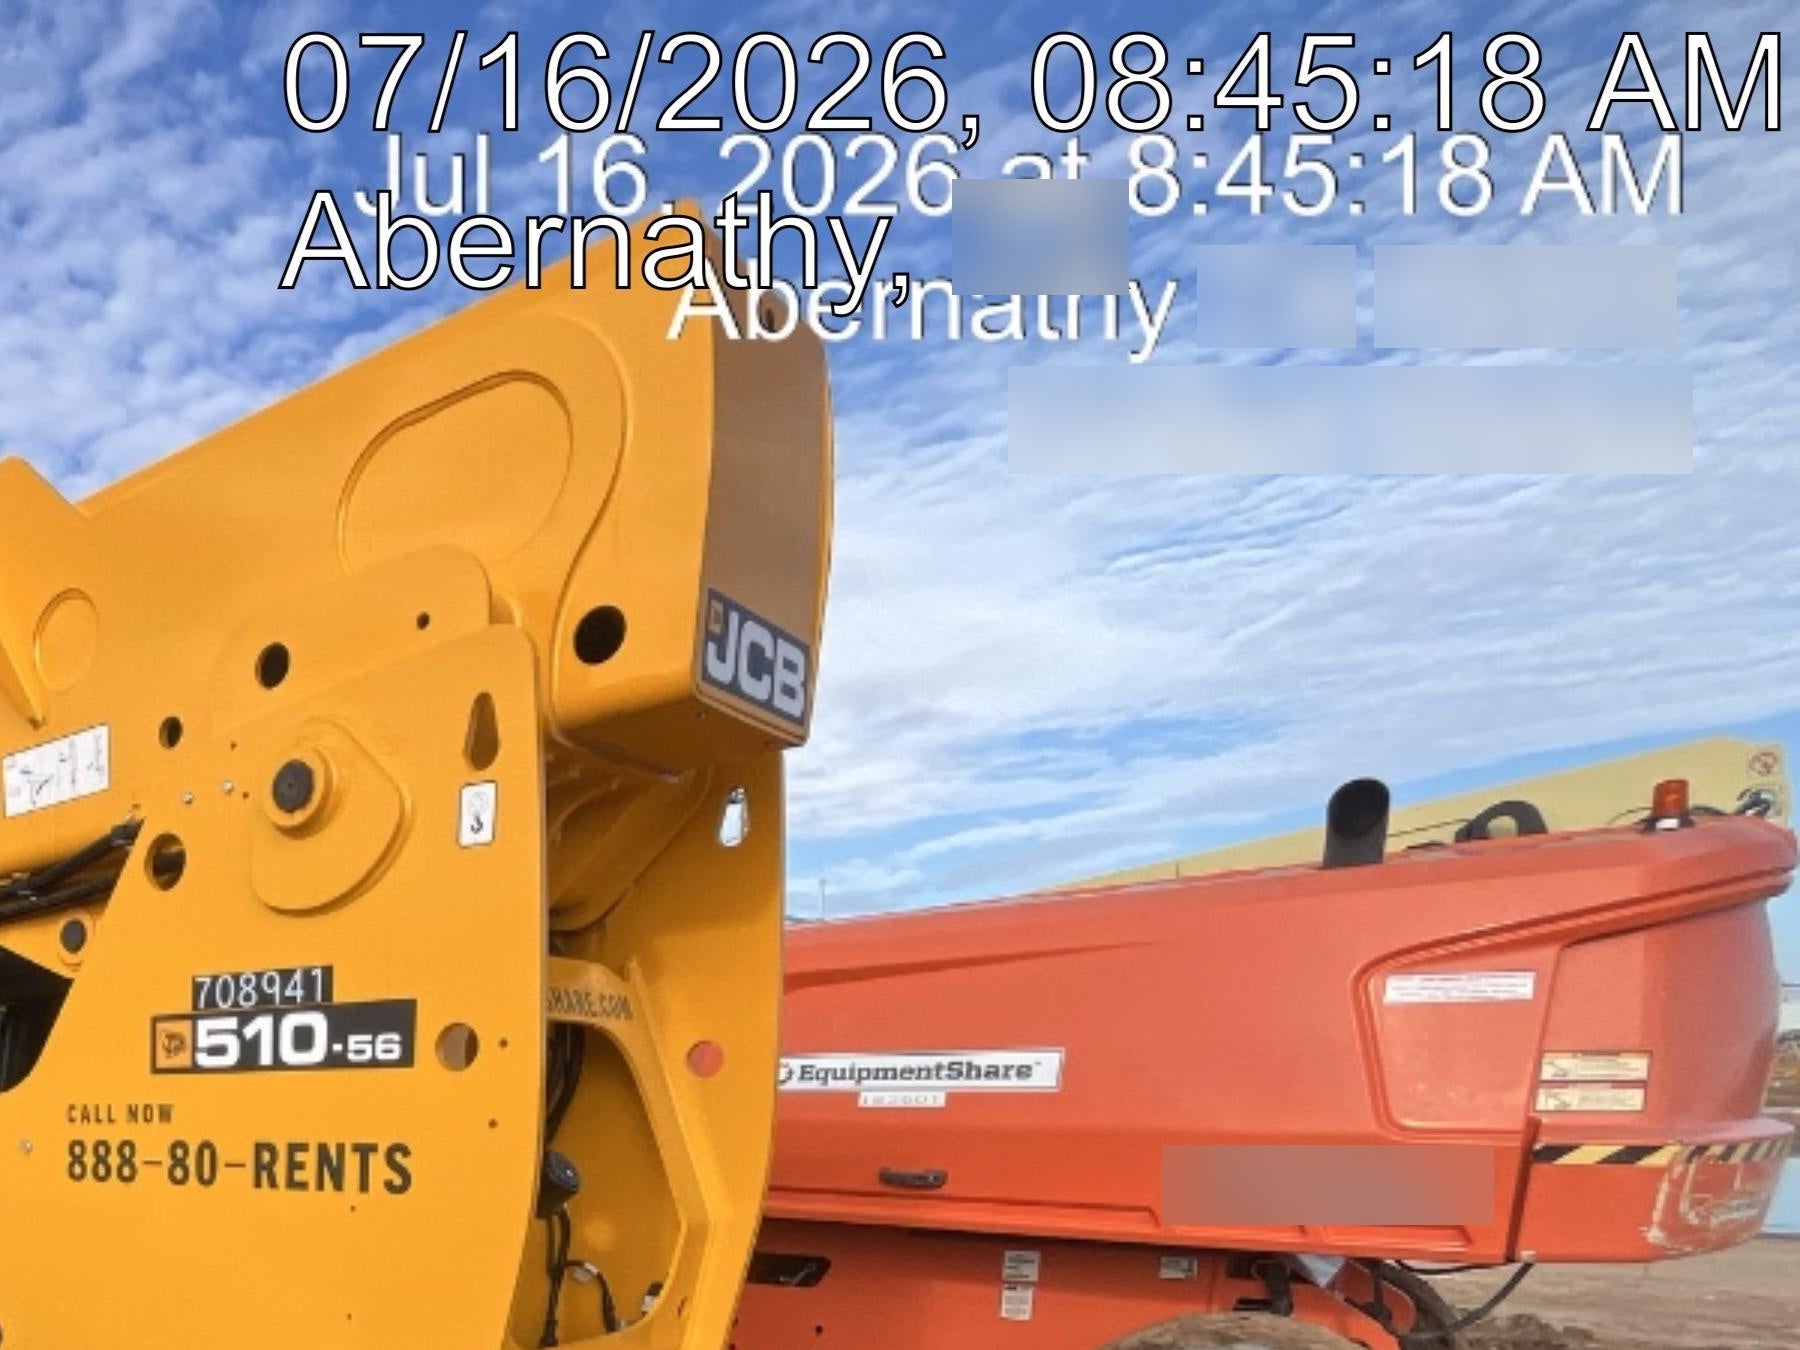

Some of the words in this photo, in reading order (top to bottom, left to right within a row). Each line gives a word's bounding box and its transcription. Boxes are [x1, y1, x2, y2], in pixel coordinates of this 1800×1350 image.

[707, 609, 806, 718] JCB
[194, 967, 323, 1010] 708941
[194, 1010, 402, 1069] 510-56
[67, 1103, 117, 1124] CALL
[125, 1103, 175, 1124] NOW
[67, 1138, 412, 1195] 888-80-RENTS
